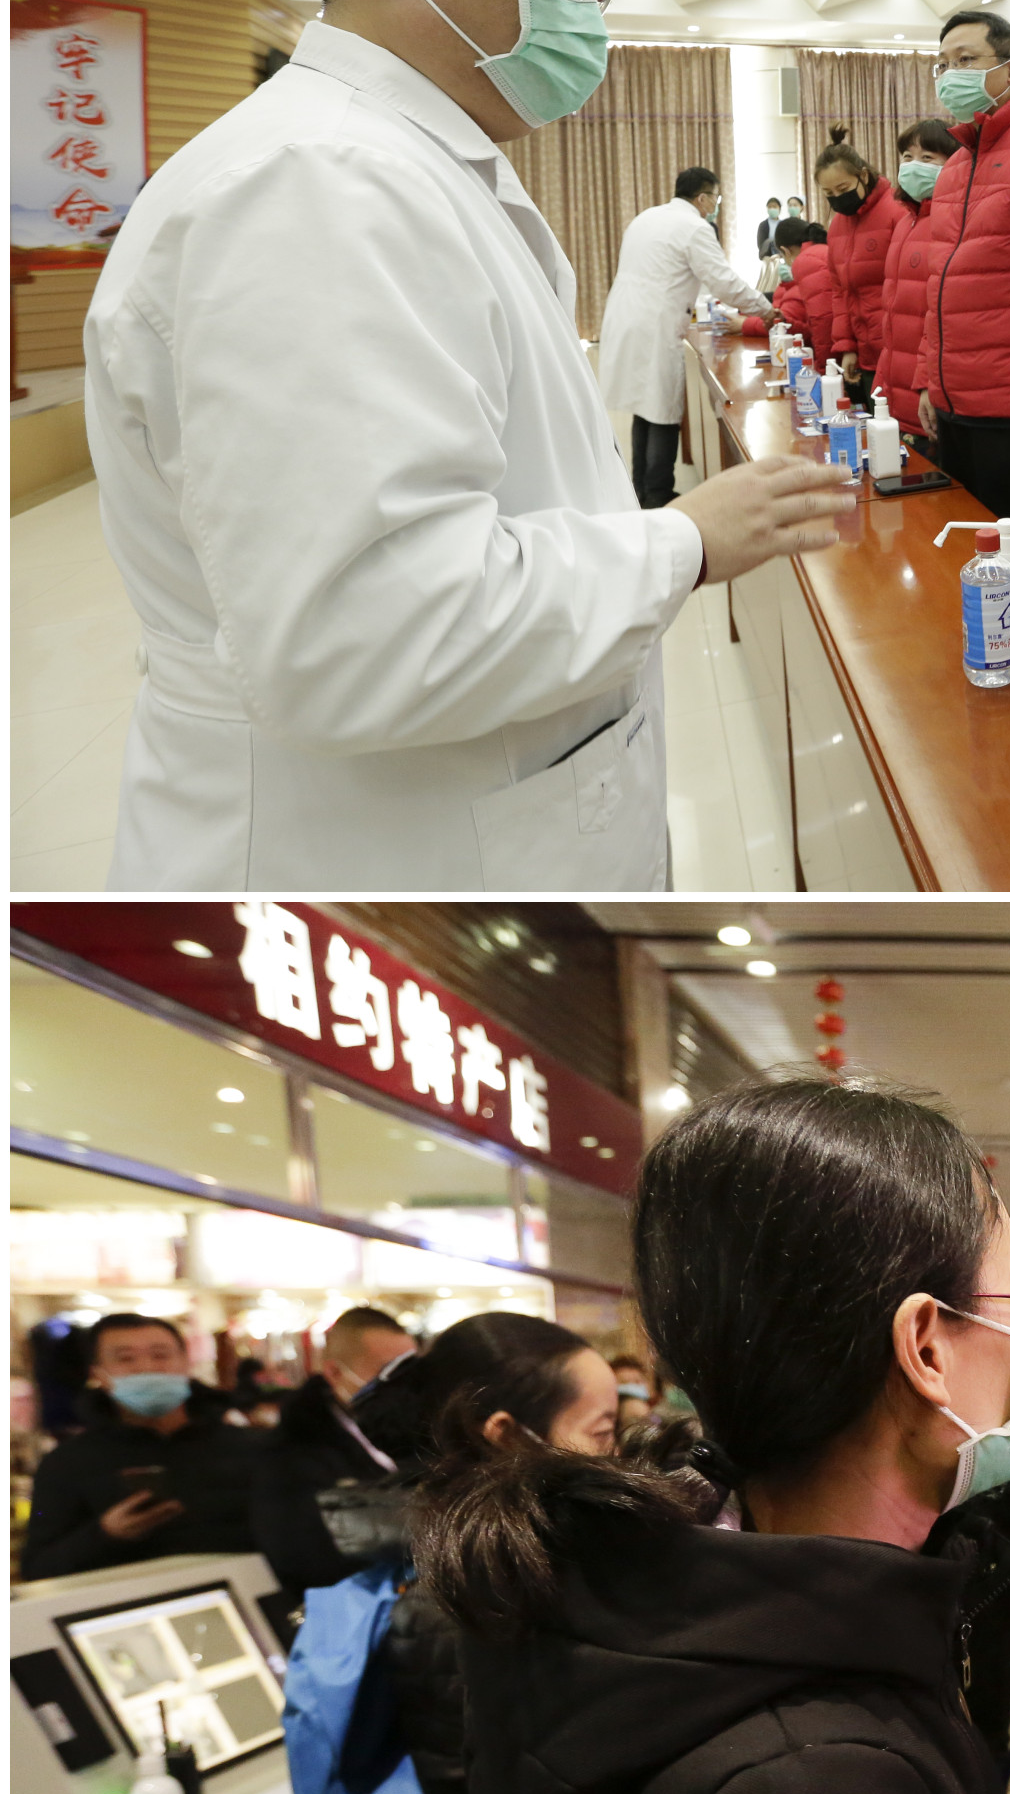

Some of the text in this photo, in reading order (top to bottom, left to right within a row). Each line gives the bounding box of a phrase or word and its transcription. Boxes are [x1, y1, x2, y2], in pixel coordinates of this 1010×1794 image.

[48, 34, 113, 232] 牢记使命
[985, 591, 1010, 600] LIRCON
[233, 902, 550, 1154] 相约特产店
